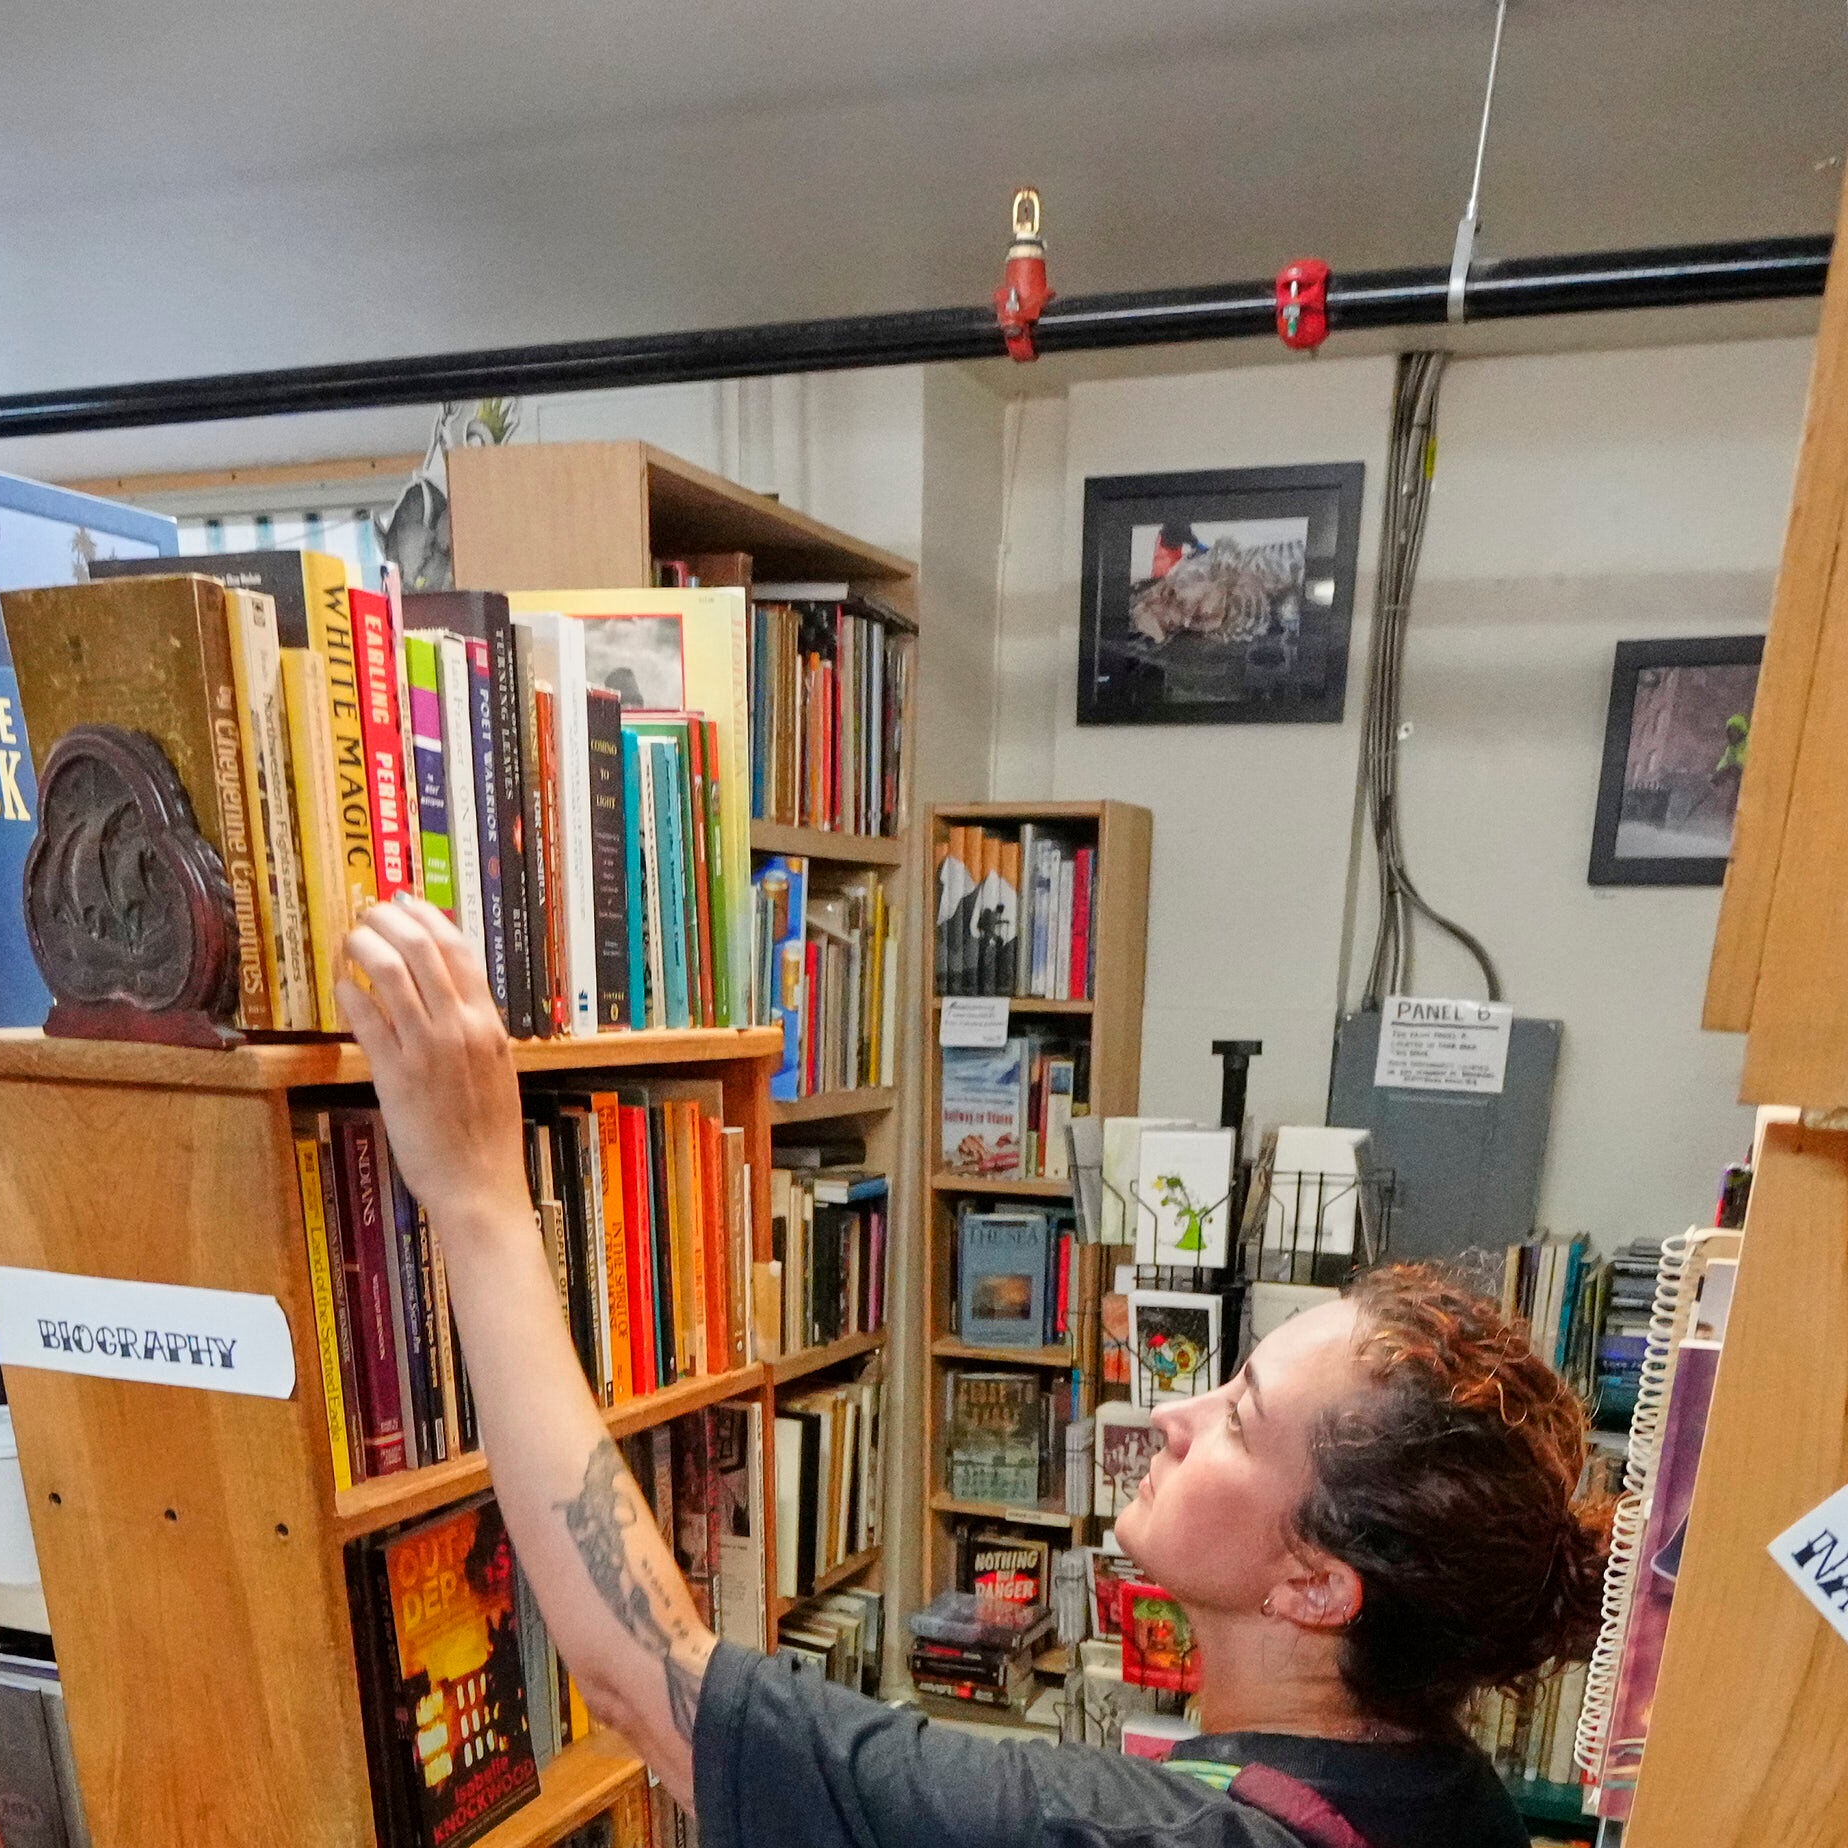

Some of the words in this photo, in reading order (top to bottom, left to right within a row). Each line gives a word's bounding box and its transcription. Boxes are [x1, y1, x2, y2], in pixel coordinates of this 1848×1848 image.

[316, 584, 362, 719] WHITE
[361, 613, 391, 724] EARLING
[477, 688, 493, 741] POET
[260, 694, 286, 814] Northwestern
[328, 732, 377, 870] MAGIC
[373, 751, 399, 834] PERMA
[480, 751, 500, 842] WARRIOR
[273, 820, 293, 875] Fights
[382, 840, 403, 883] RED
[280, 878, 297, 907] and
[488, 893, 504, 928] JOY
[283, 913, 305, 982] Fighters
[491, 936, 508, 1000] HARJO
[1397, 1001, 1463, 1020] PANEL
[351, 1138, 379, 1226] INDIANS
[309, 1226, 327, 1270] Land
[550, 1207, 568, 1266] PEOPLE
[609, 1221, 623, 1237] IN
[610, 1240, 625, 1270] THE
[314, 1275, 329, 1292] of
[558, 1277, 571, 1300] OF
[611, 1274, 627, 1315] SPIRIT
[315, 1295, 332, 1322] the
[614, 1319, 628, 1339] OF
[37, 1317, 238, 1370] BIOGRAPHY
[317, 1325, 338, 1391] Spotted
[324, 1394, 343, 1442] Eagle
[975, 1550, 1038, 1573] NOTHING
[975, 1581, 1036, 1601] DANGER
[433, 1757, 536, 1846] KNOCKWOOD
[455, 1756, 510, 1801] Isabelle
